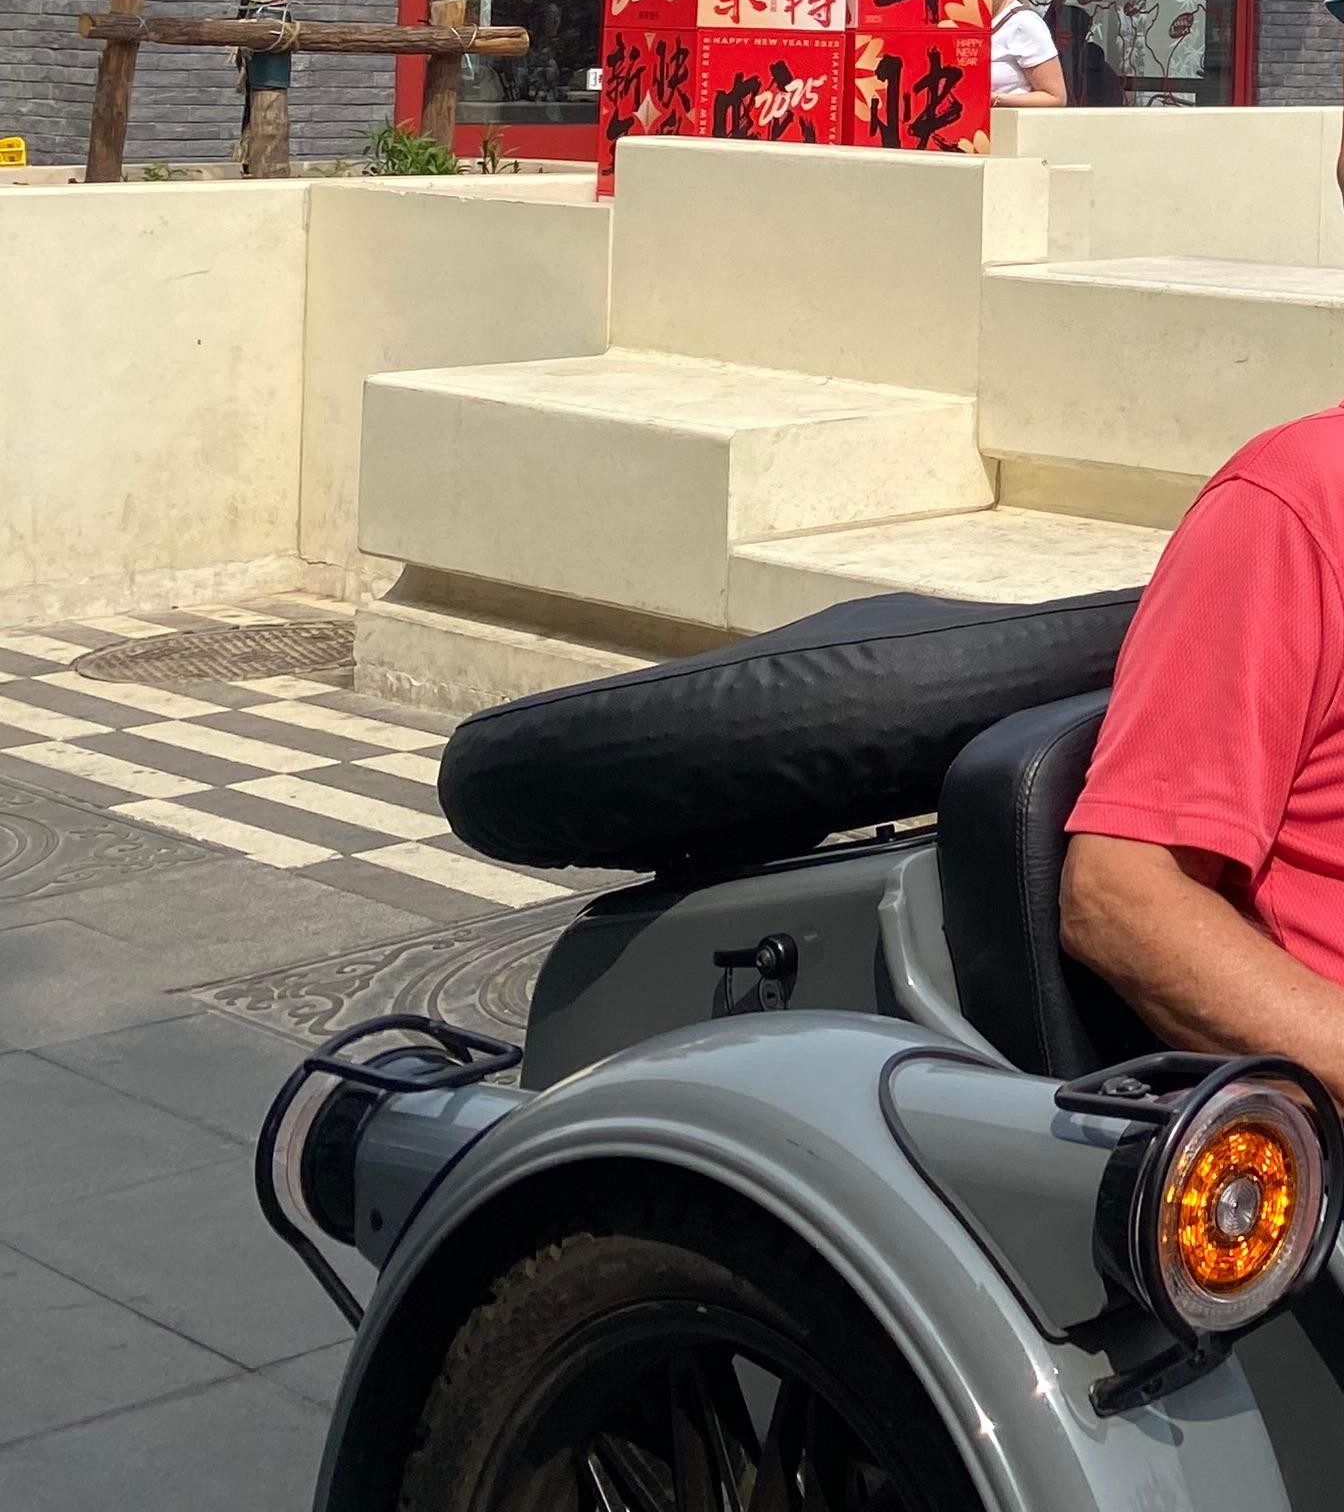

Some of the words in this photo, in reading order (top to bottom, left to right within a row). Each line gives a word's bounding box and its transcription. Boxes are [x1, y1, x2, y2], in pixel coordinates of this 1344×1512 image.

[712, 37, 750, 45] HAPPY
[782, 39, 810, 47] YEAR
[956, 38, 983, 48] HAPPY
[955, 47, 979, 57] NEW
[755, 74, 828, 126] 2025
